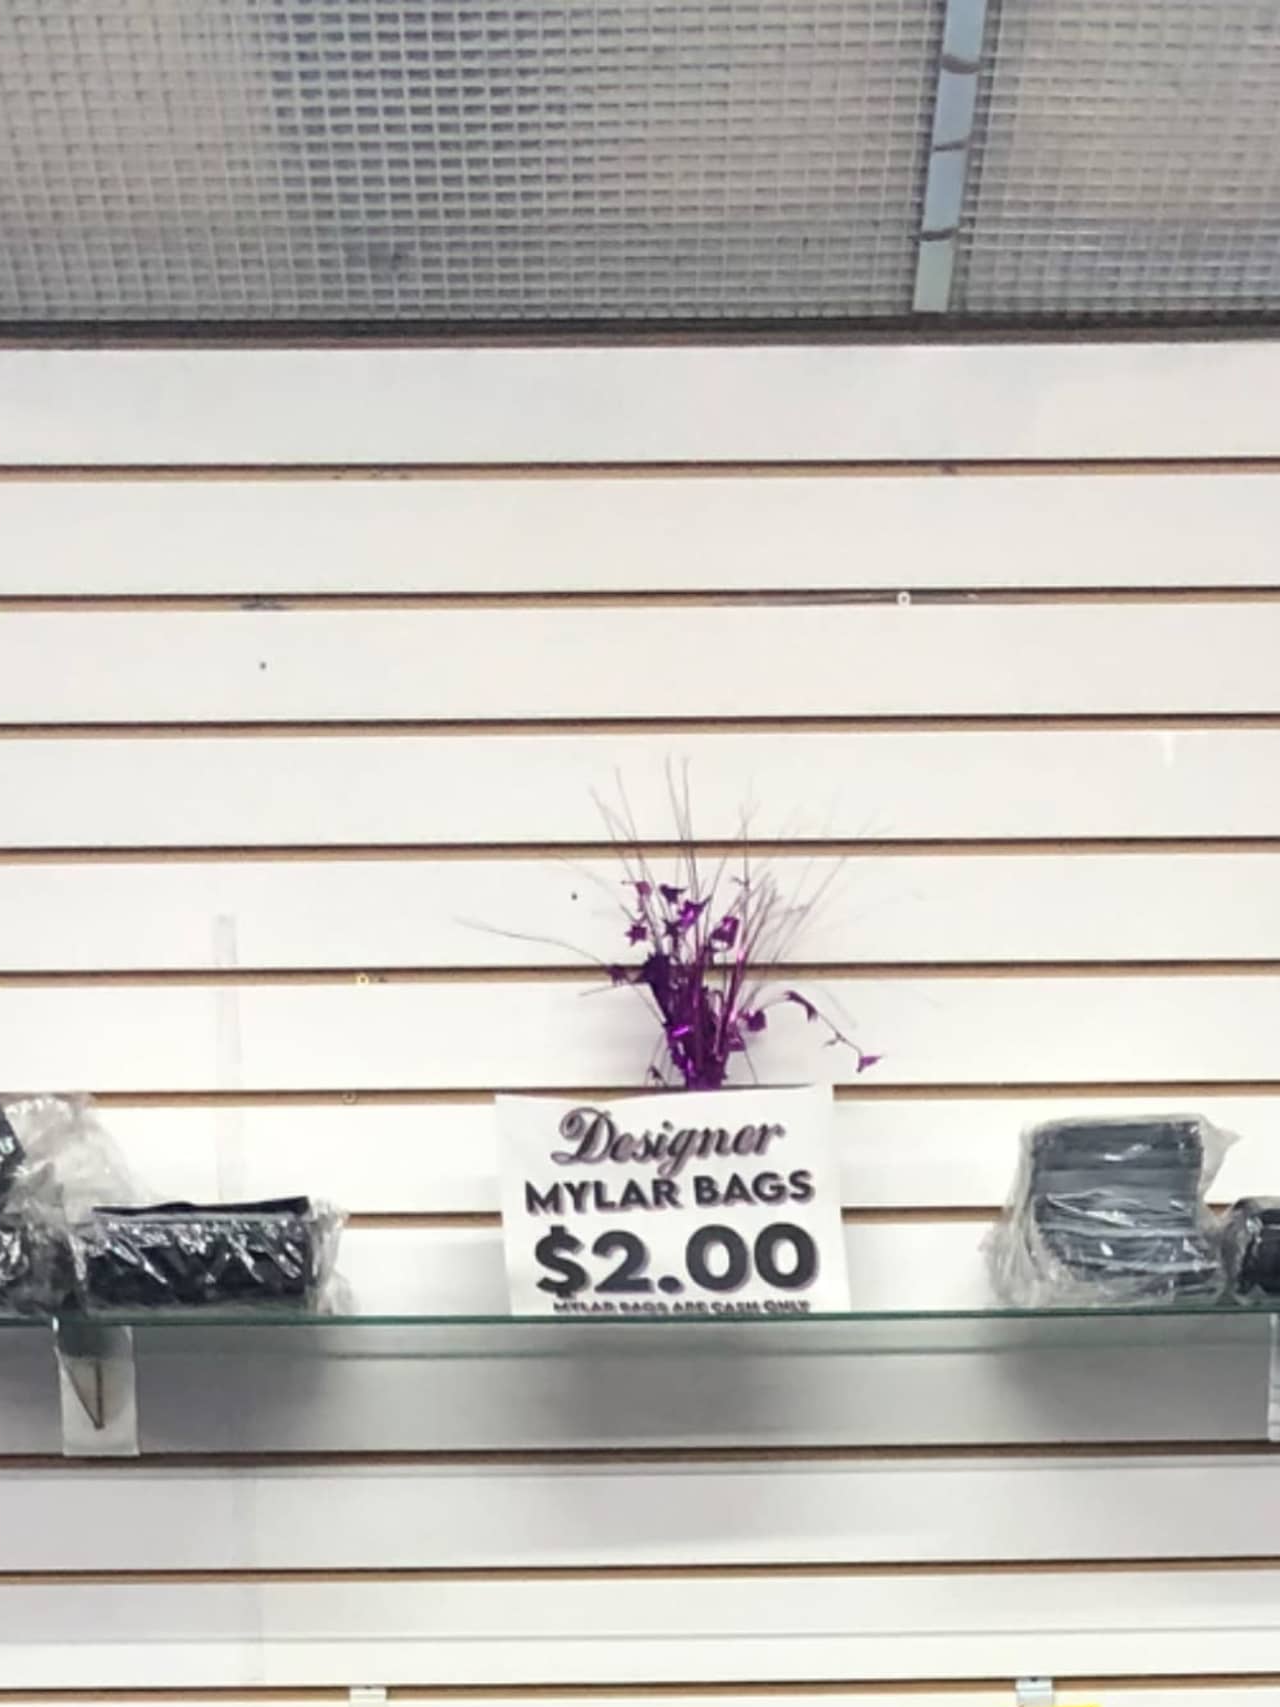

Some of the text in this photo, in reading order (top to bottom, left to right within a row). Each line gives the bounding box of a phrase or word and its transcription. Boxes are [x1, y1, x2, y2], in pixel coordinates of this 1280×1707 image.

[551, 1107, 786, 1176] Designer
[524, 1169, 816, 1215] MYLAR BAGS
[534, 1222, 820, 1298] $2.00
